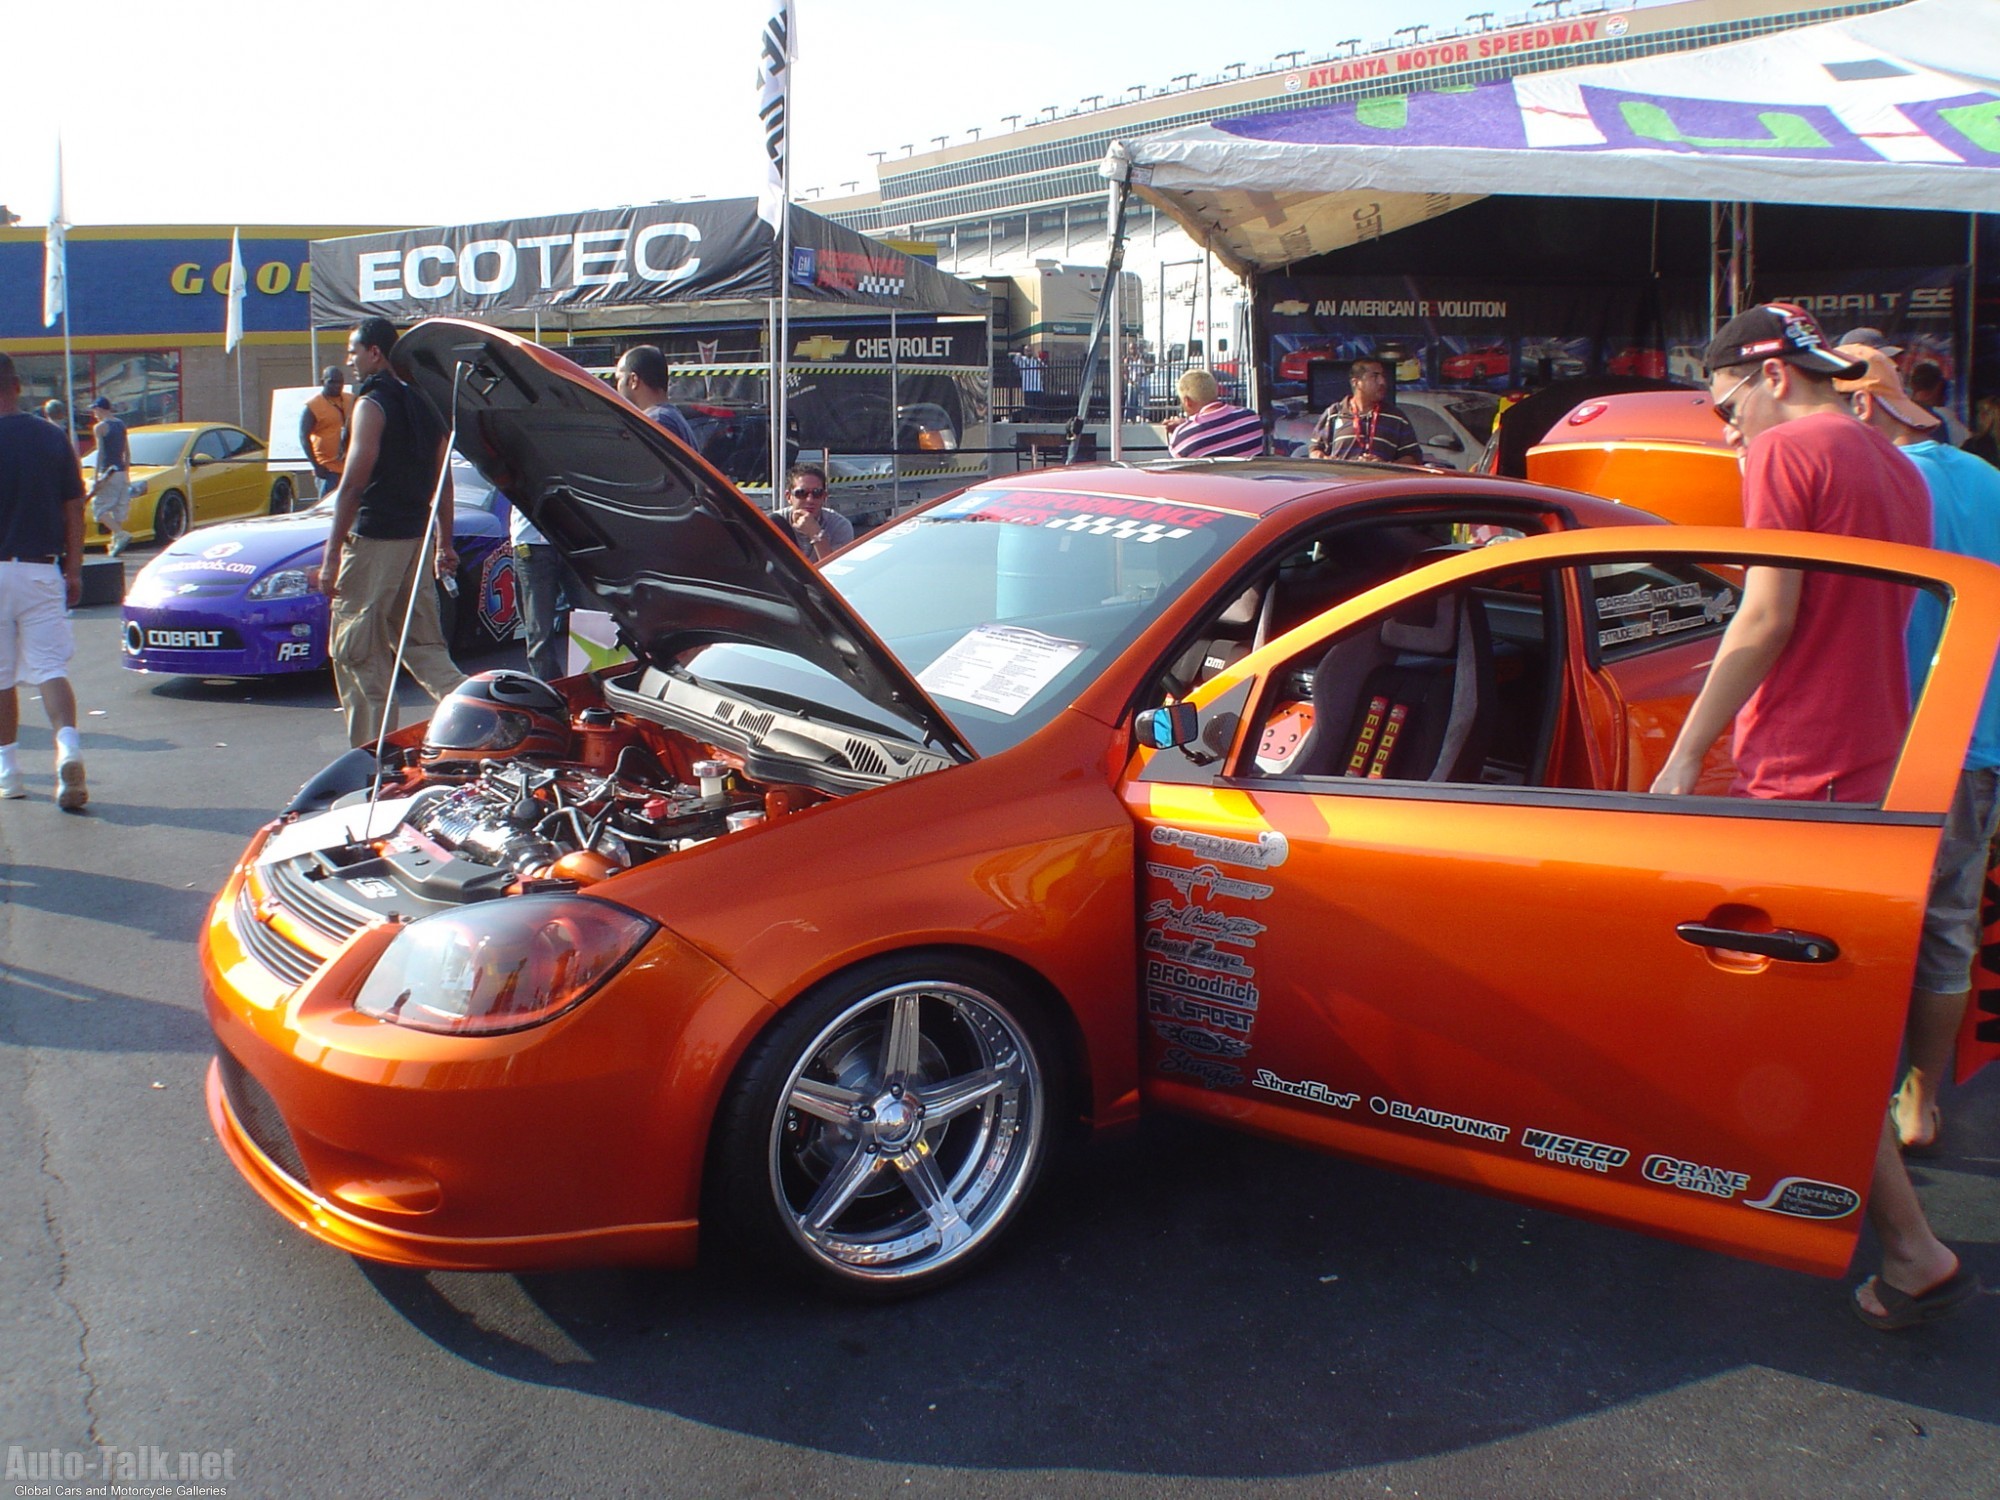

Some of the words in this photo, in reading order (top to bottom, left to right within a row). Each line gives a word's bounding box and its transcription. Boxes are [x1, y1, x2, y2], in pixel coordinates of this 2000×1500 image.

[1307, 61, 1389, 89] ATLANTA
[1396, 43, 1469, 71] MOTOR
[1478, 20, 1598, 57] SPEEDWAY
[358, 222, 702, 304] ECOTEC
[798, 256, 811, 272] GM
[1315, 300, 1335, 317] AN
[1339, 300, 1414, 318] AMERICAN
[855, 336, 953, 358] CHEVROLET
[995, 492, 1226, 528] PERFORMANCE
[148, 629, 223, 647] COBALT
[278, 642, 311, 661] ACE
[1152, 826, 1270, 858] SPEEDWAY
[1156, 868, 1209, 885] STEWART
[1210, 878, 1260, 894] WARNER
[1147, 961, 1258, 1003] BFGoodrich
[1253, 1069, 1360, 1109] StreetGlow
[1390, 1101, 1510, 1141] BLAUPUNKT
[1522, 1128, 1630, 1167] WISECO
[1535, 1148, 1608, 1172] PISTON
[1642, 1154, 1751, 1191] CRANE
